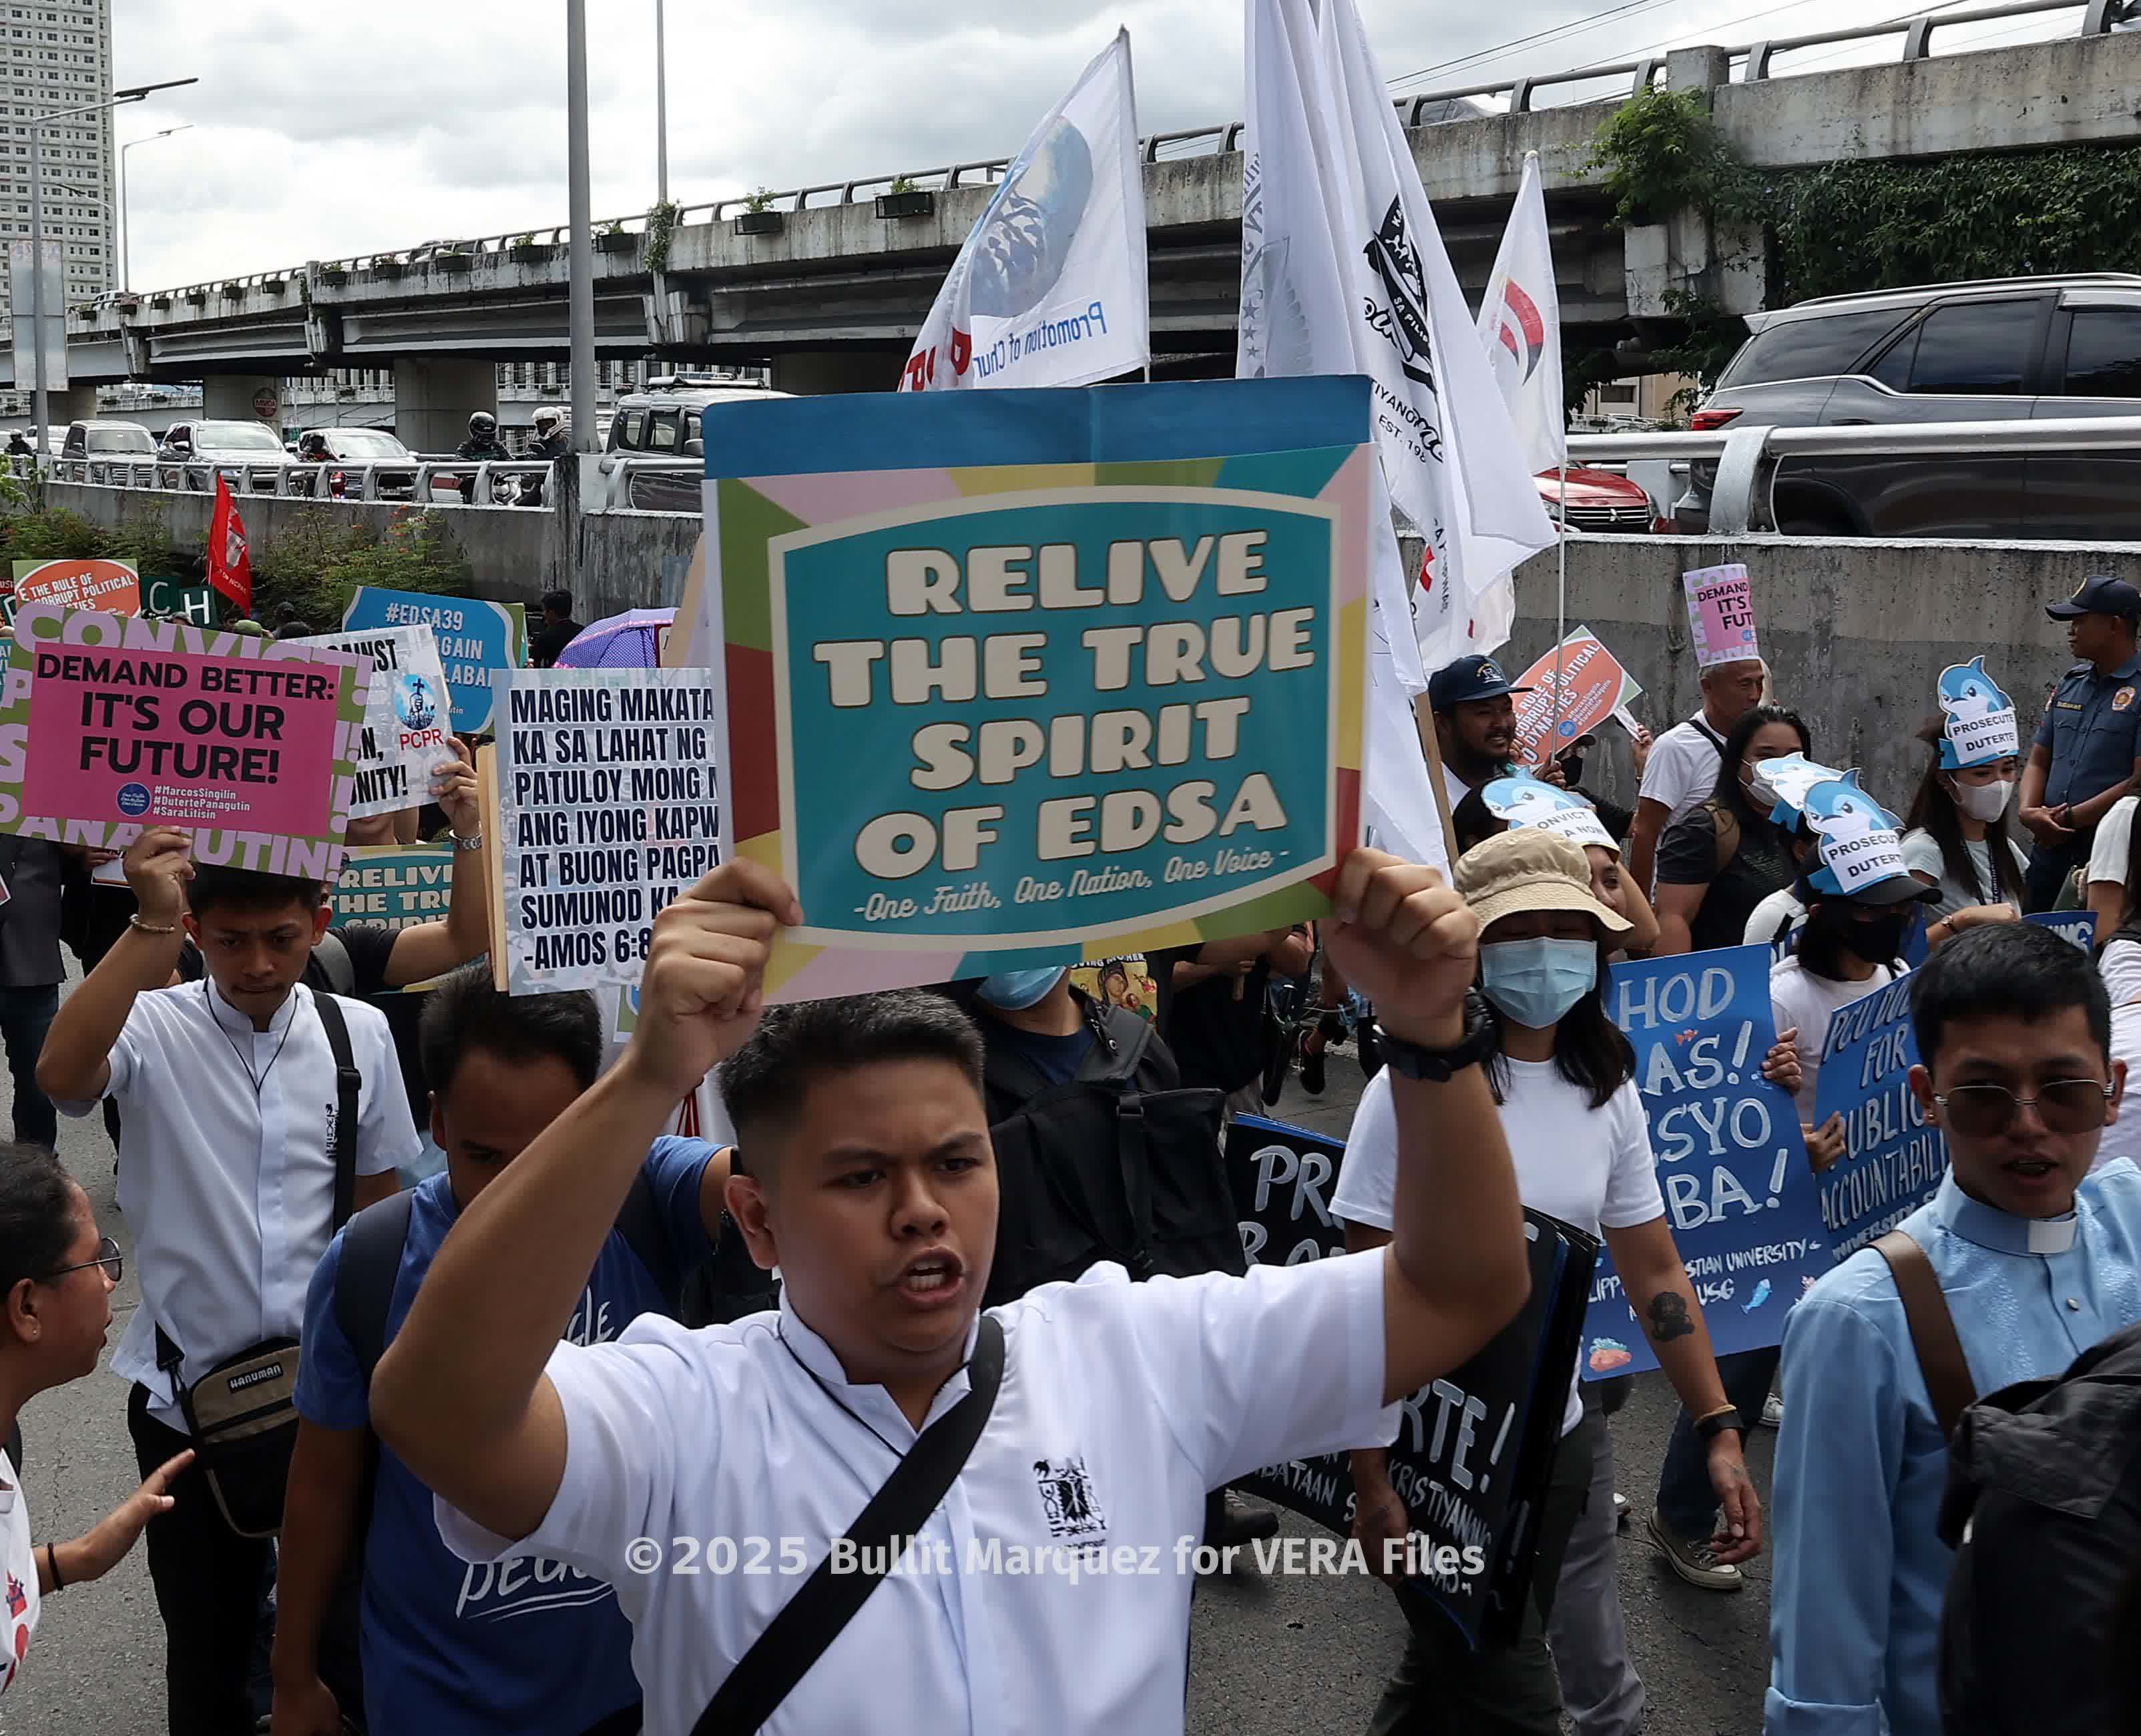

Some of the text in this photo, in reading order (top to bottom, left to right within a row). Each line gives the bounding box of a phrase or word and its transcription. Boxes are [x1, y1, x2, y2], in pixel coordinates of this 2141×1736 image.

[30, 585, 51, 599] THE
[51, 576, 79, 594] RULE
[79, 573, 93, 587] OF
[83, 575, 135, 601] POLITICAL
[885, 530, 1268, 617] RELIVE
[1698, 582, 1748, 602] DEMAND
[385, 602, 463, 632] #EDSA39
[1717, 595, 1747, 613] IT'S
[37, 653, 188, 690] DEMAND
[202, 664, 336, 701] BETTER:
[812, 606, 1316, 709] THE TRUE
[509, 688, 612, 724] MAGING
[1515, 643, 1601, 738] CORRUPT OLITICAL
[1519, 668, 1558, 710] RULE OF
[80, 691, 284, 741] IT'S OUR
[1953, 713, 2014, 736] PROSECUTE
[399, 728, 444, 751] PCPR
[513, 727, 706, 765] KA SA LAHAT NG
[909, 696, 1251, 791] SPIRIT
[1965, 732, 2015, 752] DUTERTE
[79, 736, 280, 785] FUTURE!
[153, 796, 250, 812] #DutertePanagutin
[154, 785, 236, 800] #MarcosSingilin
[515, 768, 622, 806] PATULOY
[631, 767, 701, 801] MONG
[152, 806, 216, 820] #SaraLitisin
[517, 805, 720, 848] ANG IYONG KAPW
[854, 772, 1288, 880] OF EDSA
[1537, 810, 1587, 829] ONVICT
[519, 844, 721, 888] AT BUONG PAGPA
[923, 881, 1002, 915] Faith,
[1013, 875, 1066, 904] One
[1066, 865, 1154, 898] Nation,
[1164, 856, 1210, 883] One
[1212, 846, 1275, 876] Voice
[521, 888, 644, 930] SUMUNOD
[523, 931, 607, 970] -AMOS
[1639, 1020, 1752, 1097] AS!
[1860, 1023, 1909, 1089] FOR
[1646, 1096, 1772, 1163] SYO
[1666, 1147, 1789, 1231] BA!
[1726, 1239, 1807, 1269] UNIVERSITY
